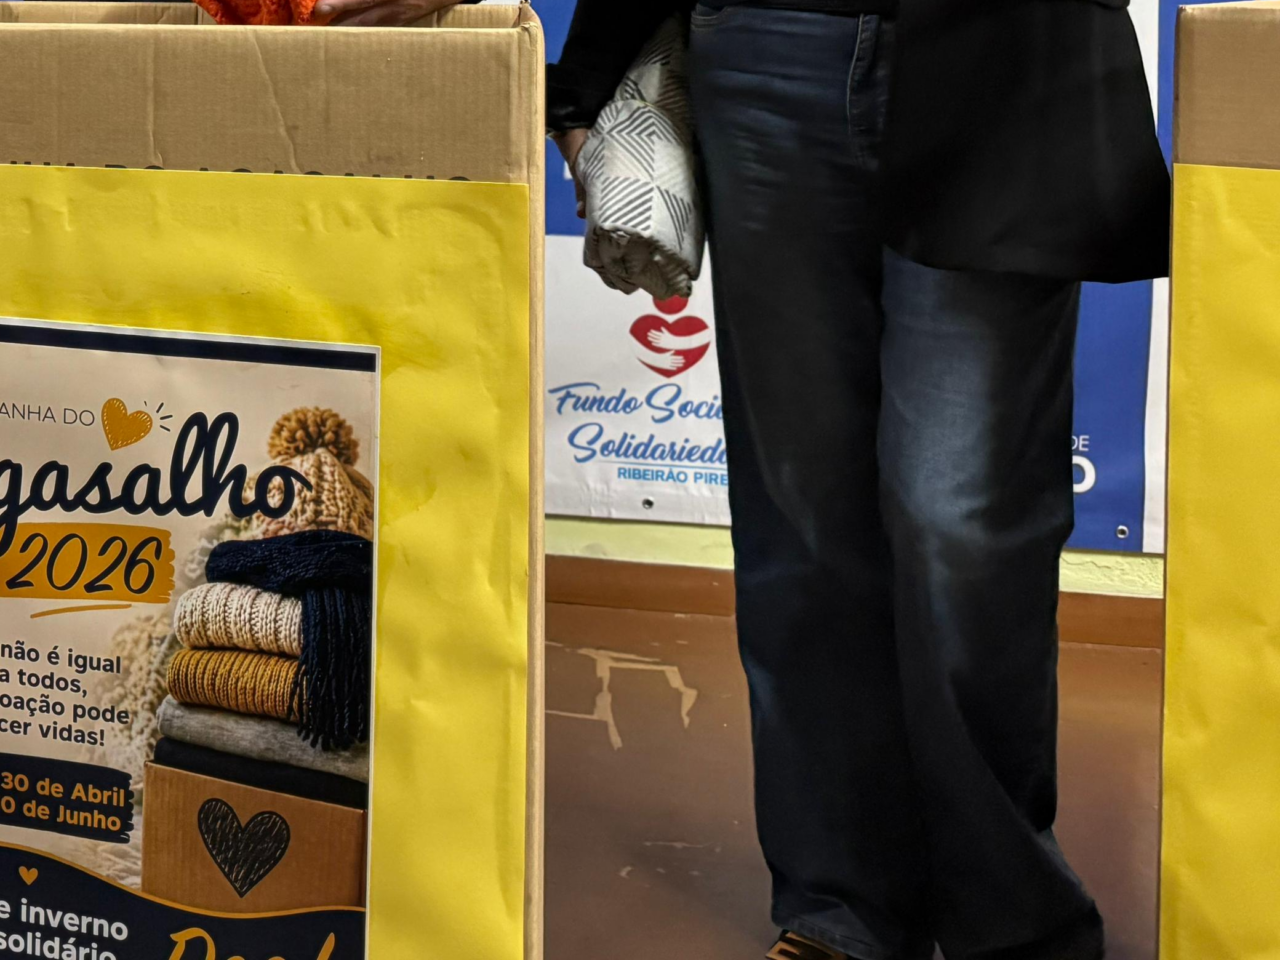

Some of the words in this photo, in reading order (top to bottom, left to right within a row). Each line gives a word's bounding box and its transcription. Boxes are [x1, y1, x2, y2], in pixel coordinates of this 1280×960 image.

[63, 408, 95, 428] DO
[548, 382, 643, 415] Fundo
[645, 383, 723, 423] Soci
[568, 423, 727, 463] Solidaried
[617, 467, 688, 483] RIBEIRÃO
[694, 472, 729, 486] PIRE
[5, 532, 163, 595] 2026
[0, 640, 40, 663] não
[47, 645, 60, 665] é
[67, 648, 121, 674] igual
[18, 668, 88, 698] todos,
[72, 704, 130, 725] pode
[39, 721, 105, 746] vidas!
[1, 771, 29, 792] 30
[36, 778, 64, 798] de
[71, 782, 125, 807] Abril
[22, 800, 50, 820] de
[56, 805, 121, 832] Junho
[20, 897, 128, 940] inverno
